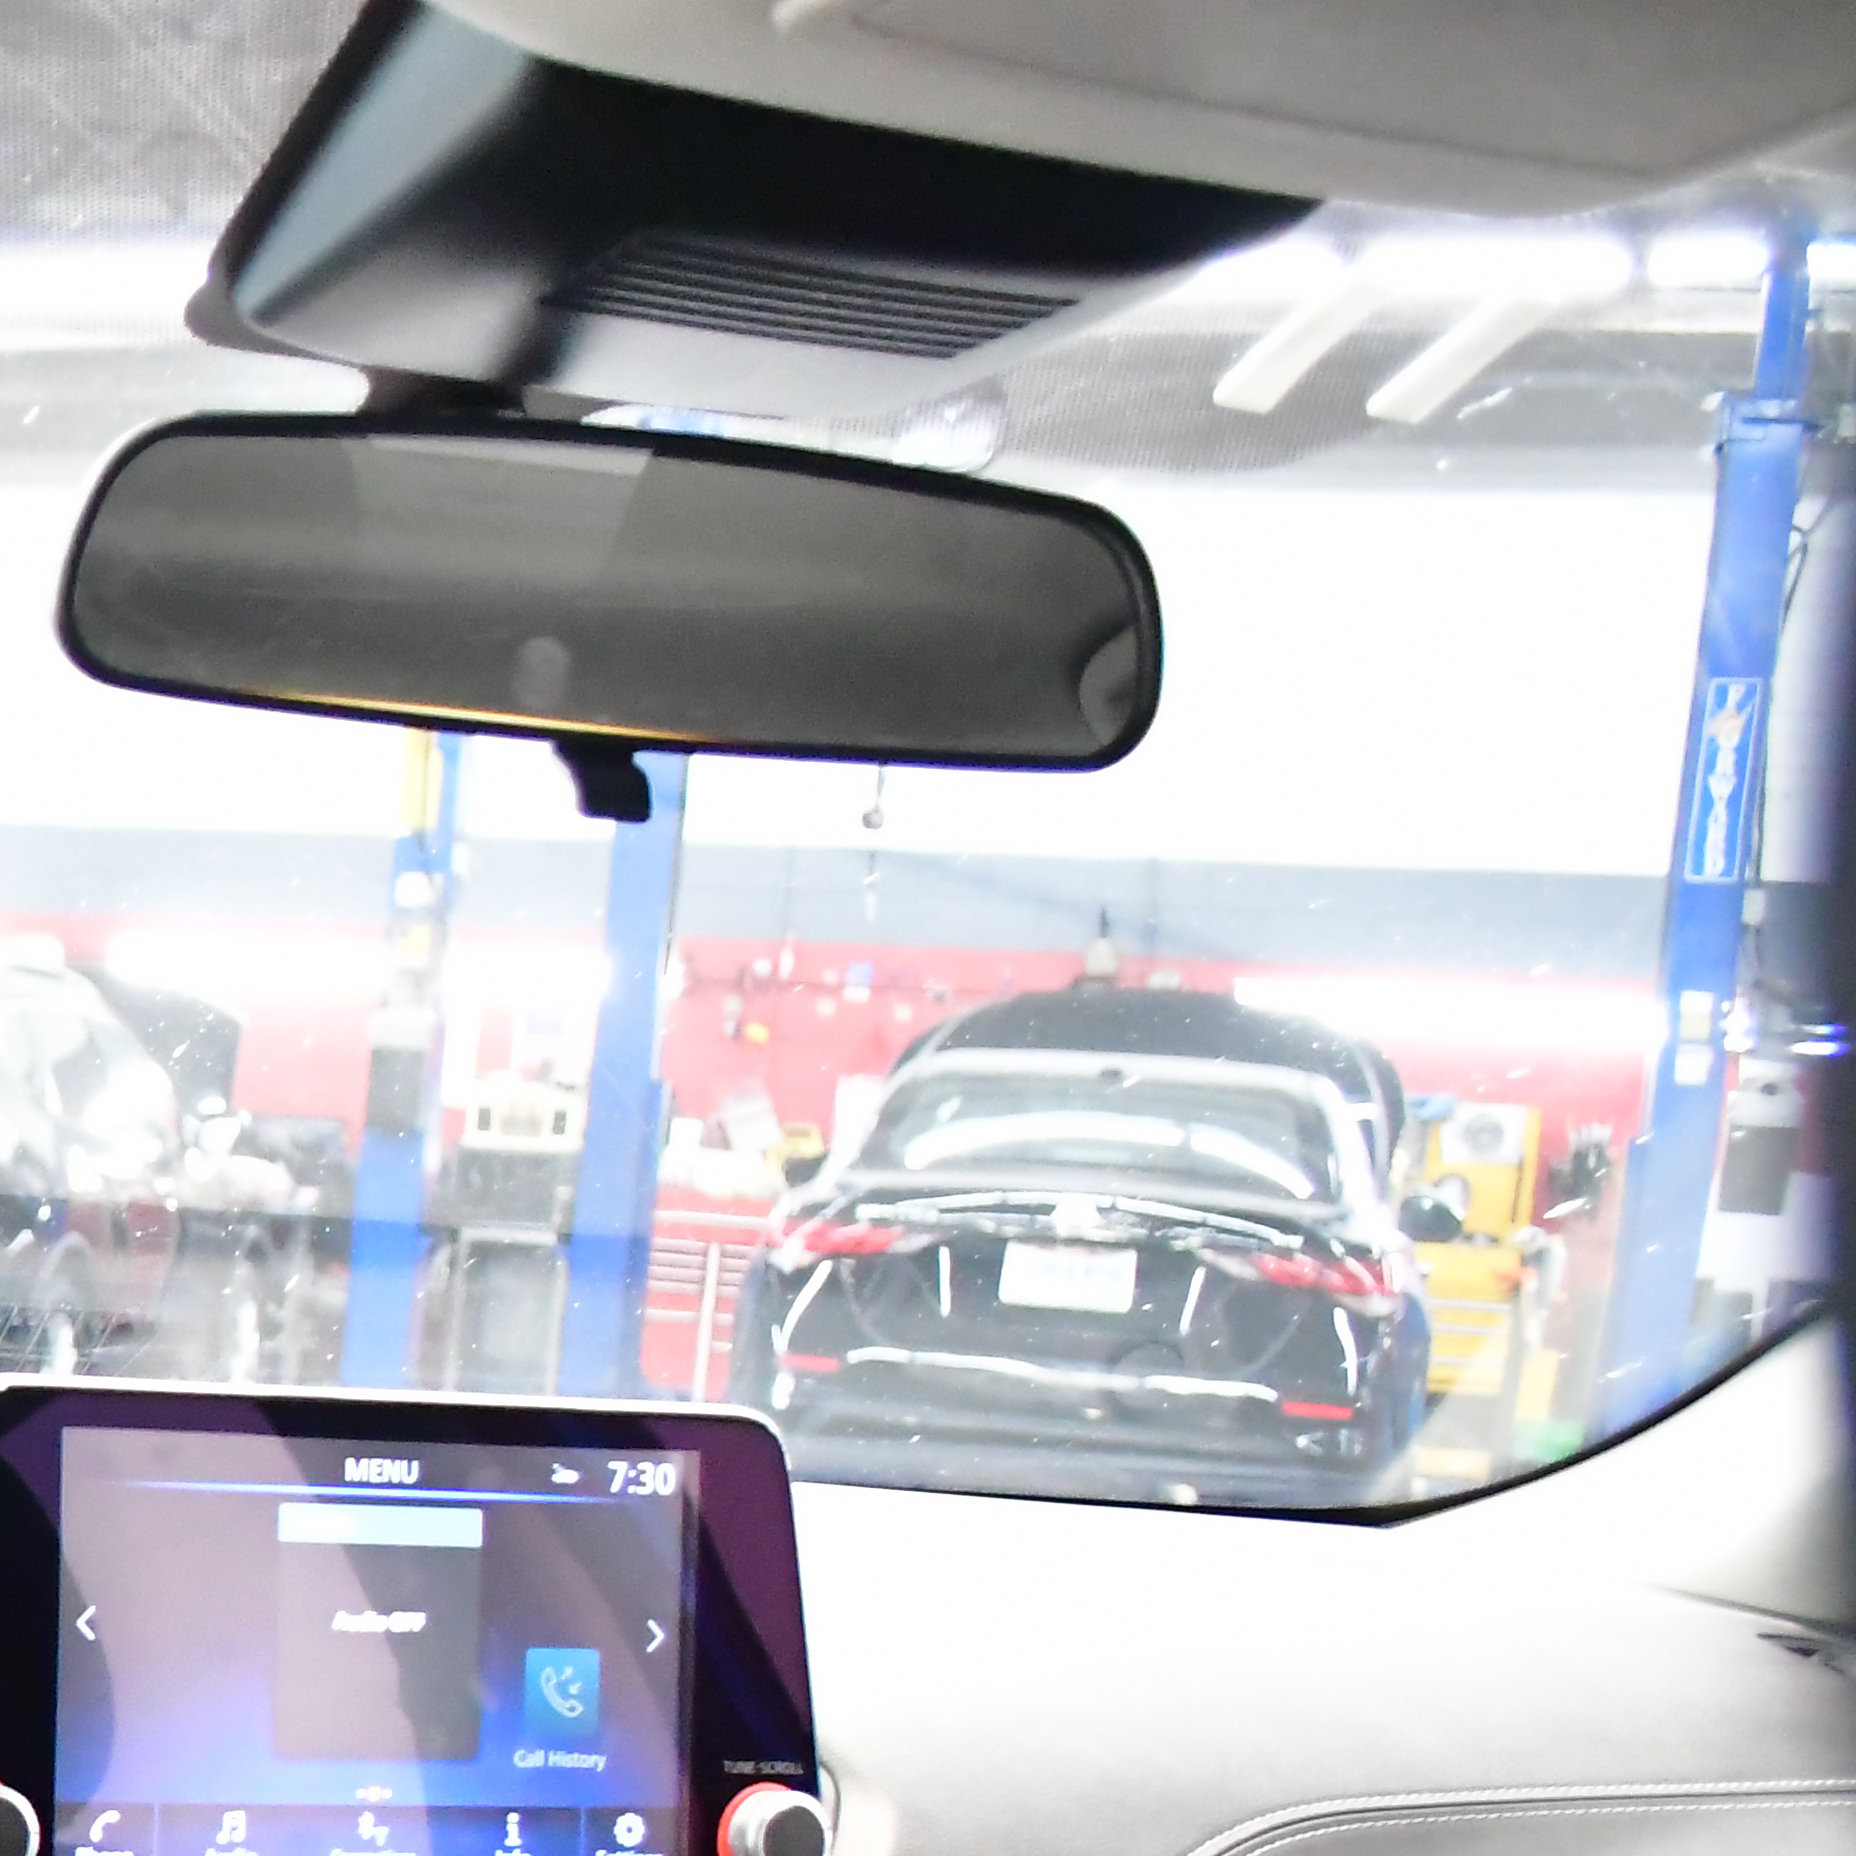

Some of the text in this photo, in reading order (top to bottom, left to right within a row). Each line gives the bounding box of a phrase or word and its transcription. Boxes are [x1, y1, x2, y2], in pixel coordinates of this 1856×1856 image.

[344, 1458, 420, 1484] MENU
[607, 1461, 677, 1496] 7:30
[514, 1750, 607, 1772] Call History
